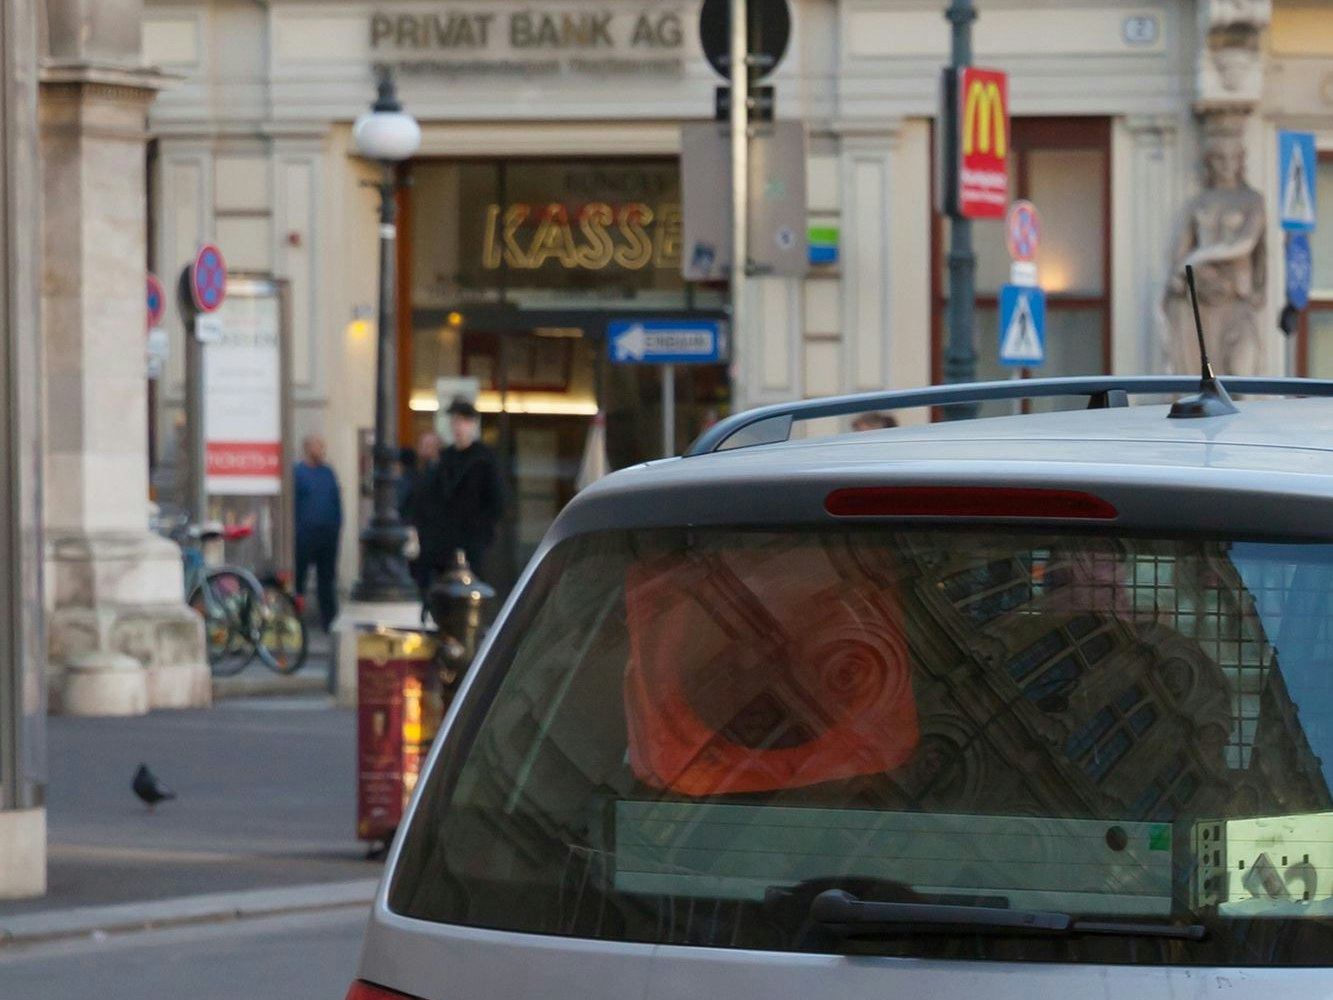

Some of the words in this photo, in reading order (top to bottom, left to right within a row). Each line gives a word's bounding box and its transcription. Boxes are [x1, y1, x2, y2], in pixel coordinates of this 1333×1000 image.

[370, 12, 493, 48] PRIVAT
[510, 12, 614, 48] BANK
[631, 13, 684, 48] AG
